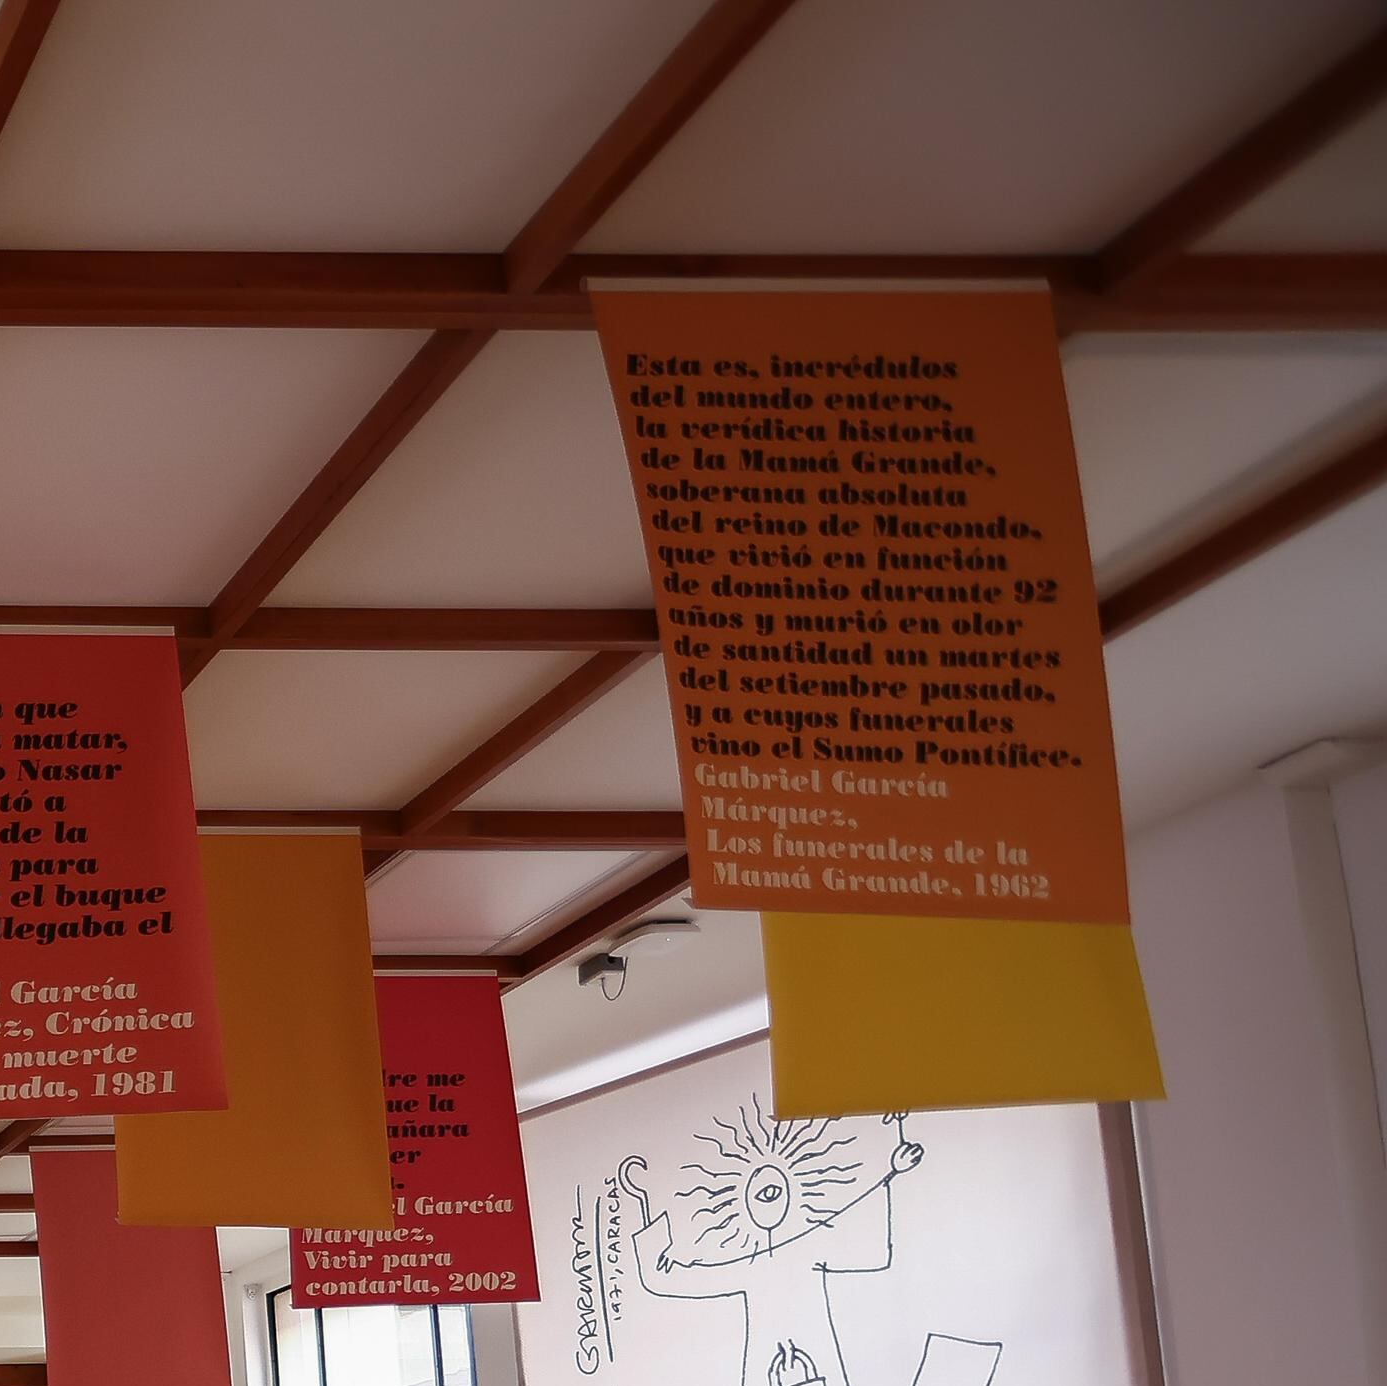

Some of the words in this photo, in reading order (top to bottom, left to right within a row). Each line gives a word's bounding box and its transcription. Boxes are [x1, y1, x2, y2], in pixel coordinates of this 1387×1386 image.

[626, 352, 703, 378] Esta
[769, 352, 961, 381] incrédulos
[14, 702, 78, 725] que
[13, 729, 128, 753] matar,
[18, 759, 123, 781] Nasar
[694, 763, 822, 793] Gabriel
[831, 770, 949, 798] García
[707, 828, 762, 855] Los
[773, 831, 934, 863] funerales
[944, 839, 985, 865] de
[996, 840, 1029, 866] la
[712, 861, 812, 889] Mamá
[975, 872, 1049, 899] 1962
[10, 976, 138, 1005] García
[45, 1007, 195, 1035] Crónica
[2, 1043, 137, 1069] muerte
[90, 1070, 176, 1097] 1981
[426, 1073, 466, 1087] me
[429, 1093, 456, 1113] la
[414, 1193, 514, 1216] García
[604, 1177, 622, 1264] CARACAS
[303, 1249, 373, 1270] Vivir
[382, 1252, 453, 1273] para
[305, 1274, 440, 1297] contarla,
[448, 1271, 517, 1292] 2002
